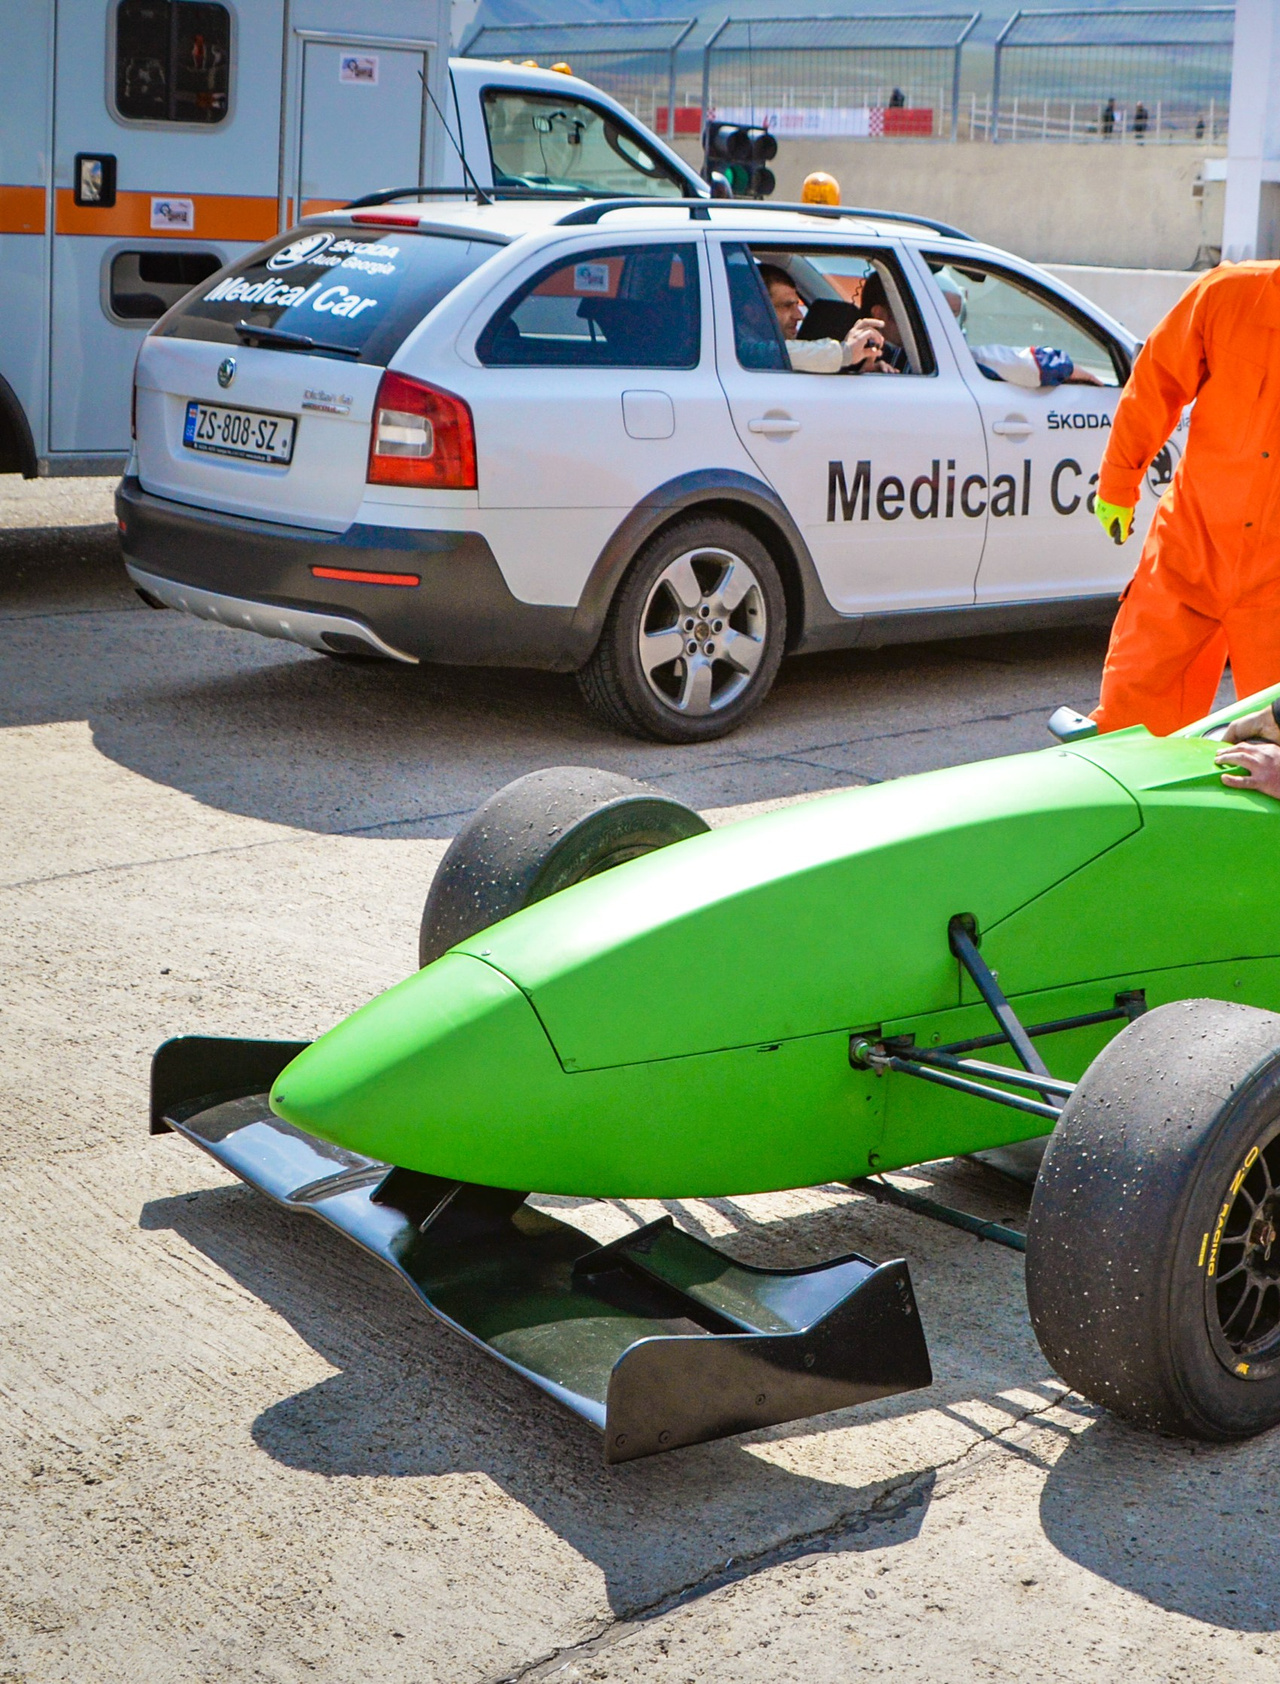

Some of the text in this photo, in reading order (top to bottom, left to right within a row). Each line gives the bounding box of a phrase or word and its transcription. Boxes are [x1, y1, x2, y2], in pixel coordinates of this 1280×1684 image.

[307, 254, 396, 275] Auto Georgia
[203, 277, 377, 319] Medical Car
[197, 409, 279, 451] ZS-808-SZ
[1047, 411, 1112, 430] ŠKODA
[826, 458, 1100, 522] Medical Ca
[1207, 1203, 1230, 1277] RACING
